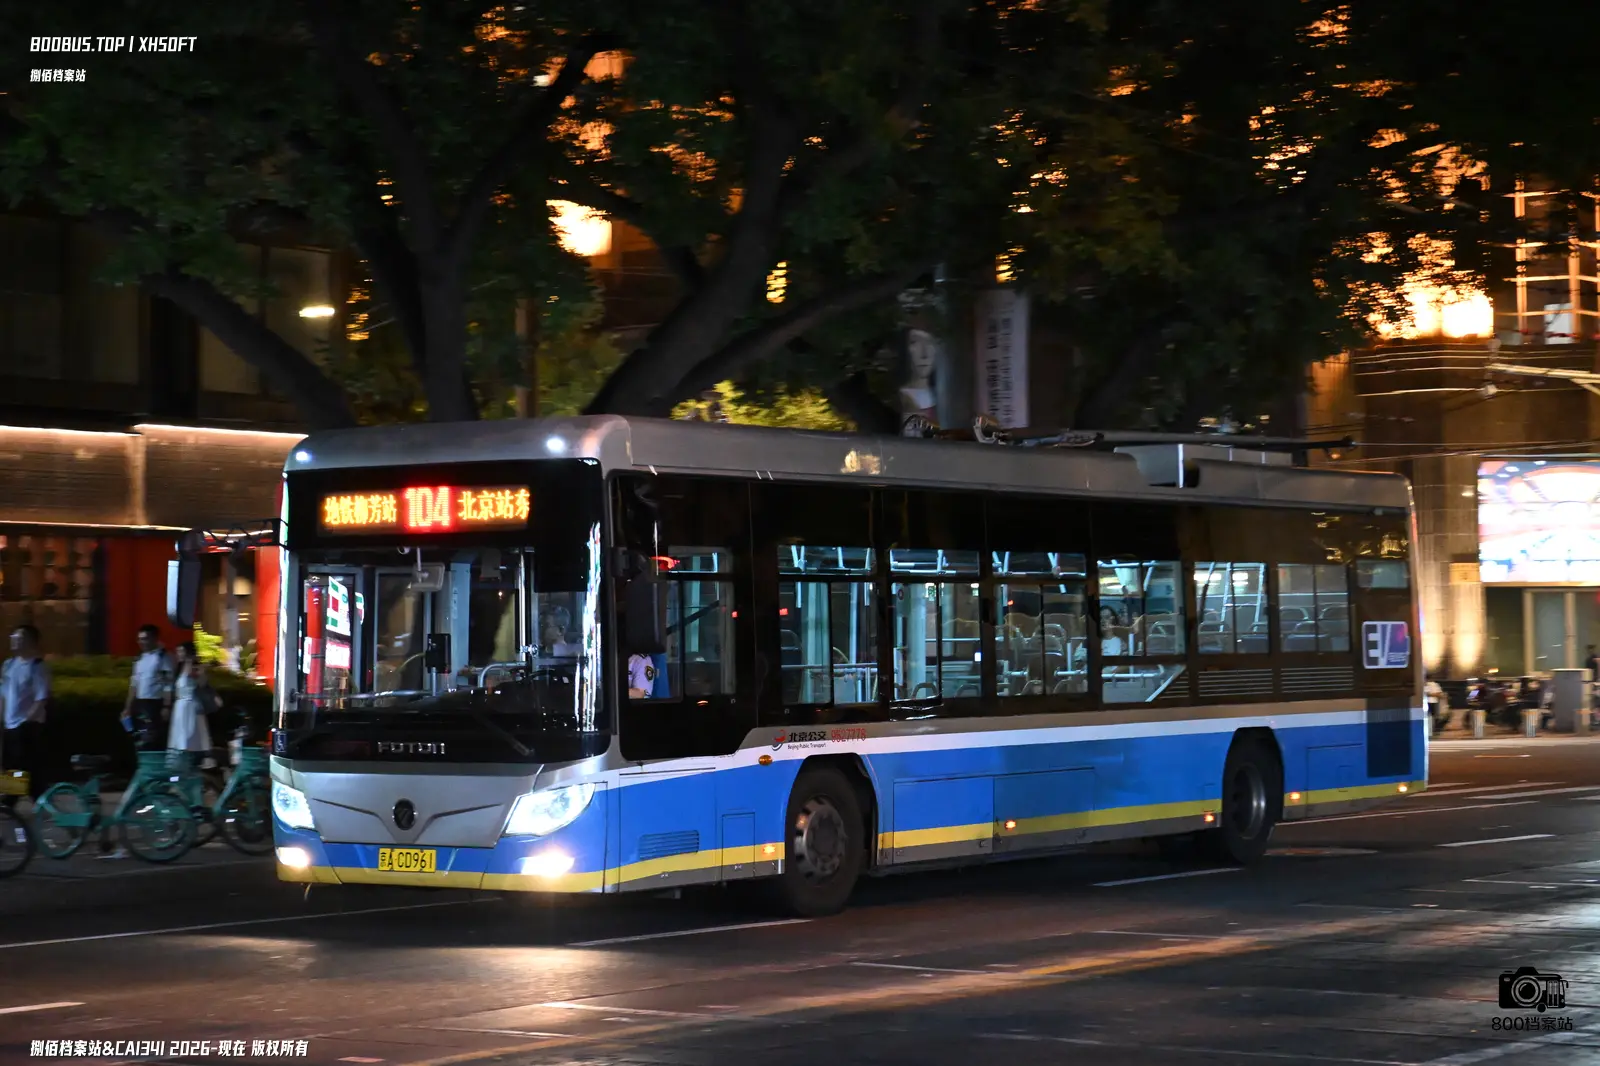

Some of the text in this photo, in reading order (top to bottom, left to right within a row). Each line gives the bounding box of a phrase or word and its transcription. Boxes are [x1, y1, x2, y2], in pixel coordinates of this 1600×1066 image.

[324, 486, 531, 528] 地铁柳芳站 104 北京站东
[788, 730, 827, 742] 北京公交
[377, 741, 445, 755] FOTON
[787, 743, 799, 751] Beijing
